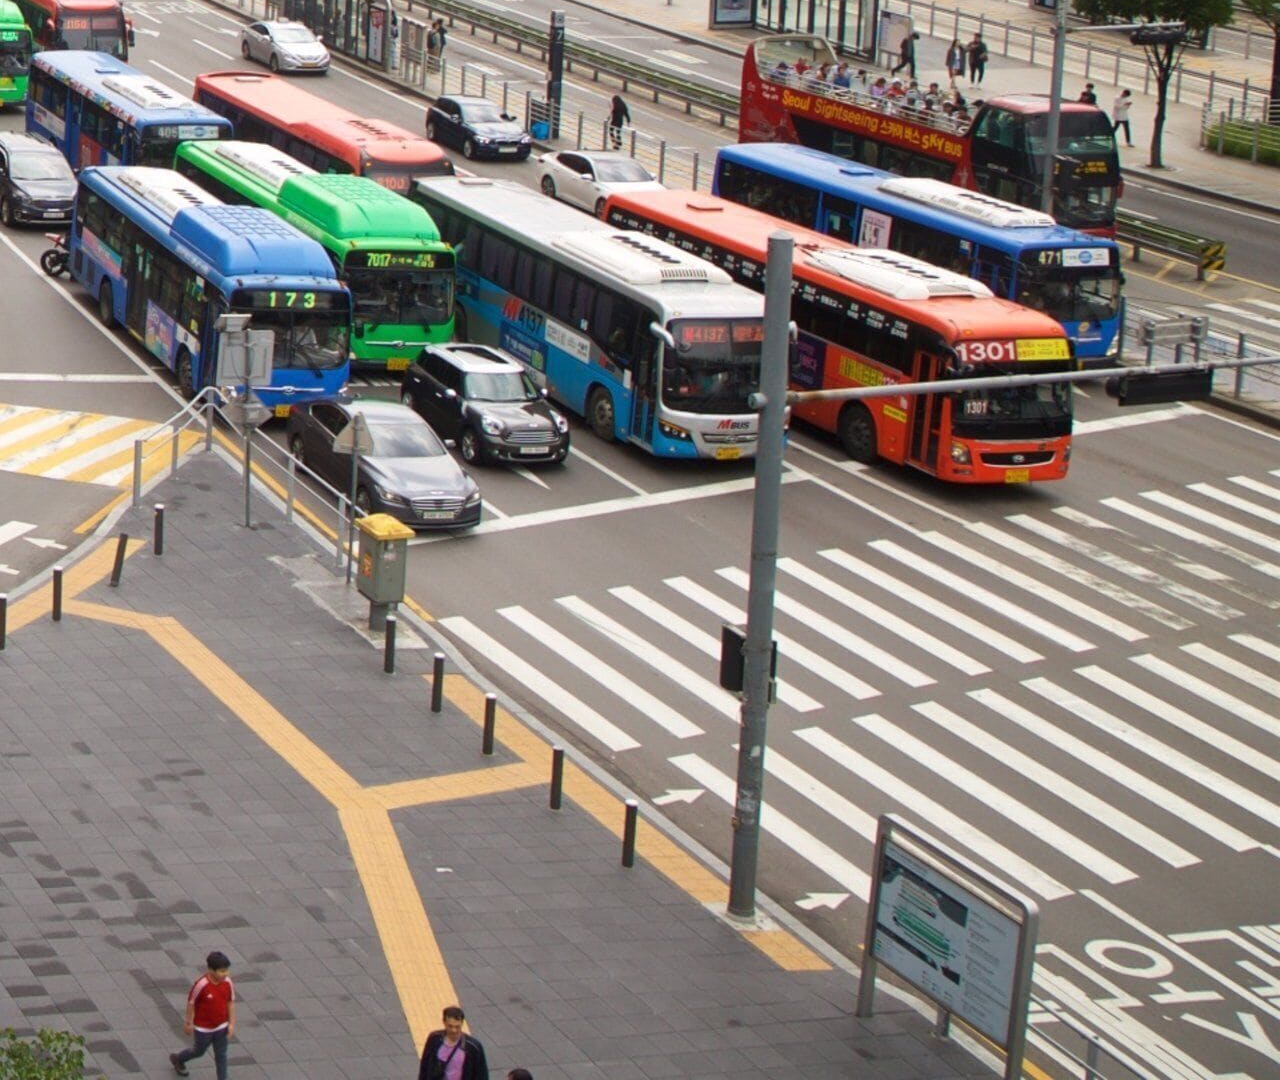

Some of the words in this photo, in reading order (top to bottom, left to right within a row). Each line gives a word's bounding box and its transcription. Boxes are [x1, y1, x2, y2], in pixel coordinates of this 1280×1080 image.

[557, 29, 563, 40] 7
[782, 89, 811, 112] Seoul
[814, 98, 879, 133] Sightseeing
[944, 142, 962, 157] BUS
[366, 252, 392, 267] 7017
[1038, 251, 1061, 265] 471
[269, 292, 316, 308] 173
[955, 341, 1016, 362] 1301
[966, 401, 989, 415] 1301
